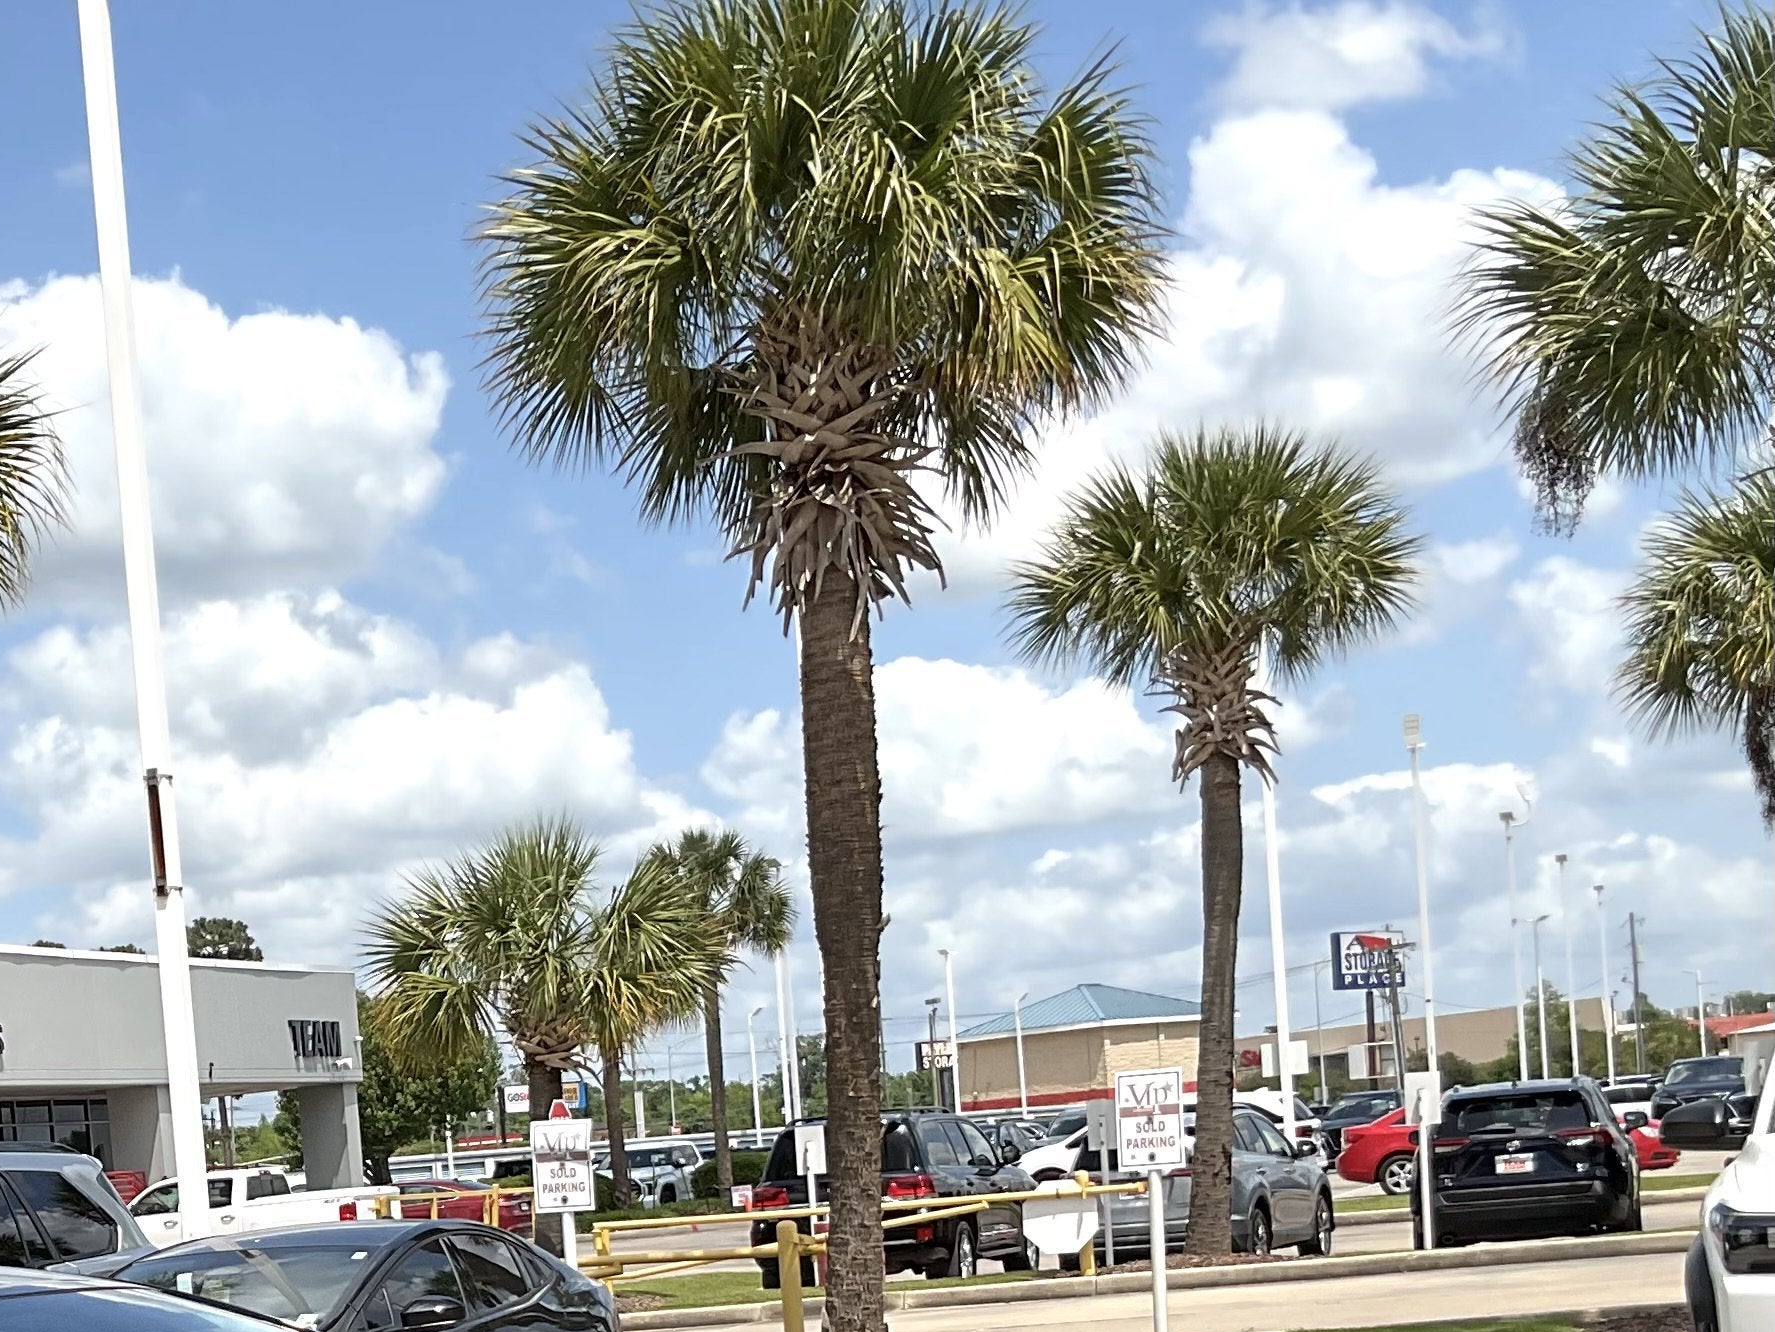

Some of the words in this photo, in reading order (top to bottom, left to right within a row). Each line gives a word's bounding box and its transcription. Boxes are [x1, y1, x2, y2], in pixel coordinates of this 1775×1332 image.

[1345, 972, 1402, 985] PLACE
[288, 1020, 342, 1057] TEAM
[1136, 1121, 1166, 1134] SOLD
[1126, 1136, 1176, 1149] PARKING
[550, 1168, 577, 1179] SOLD
[542, 1182, 586, 1194] PARKING
